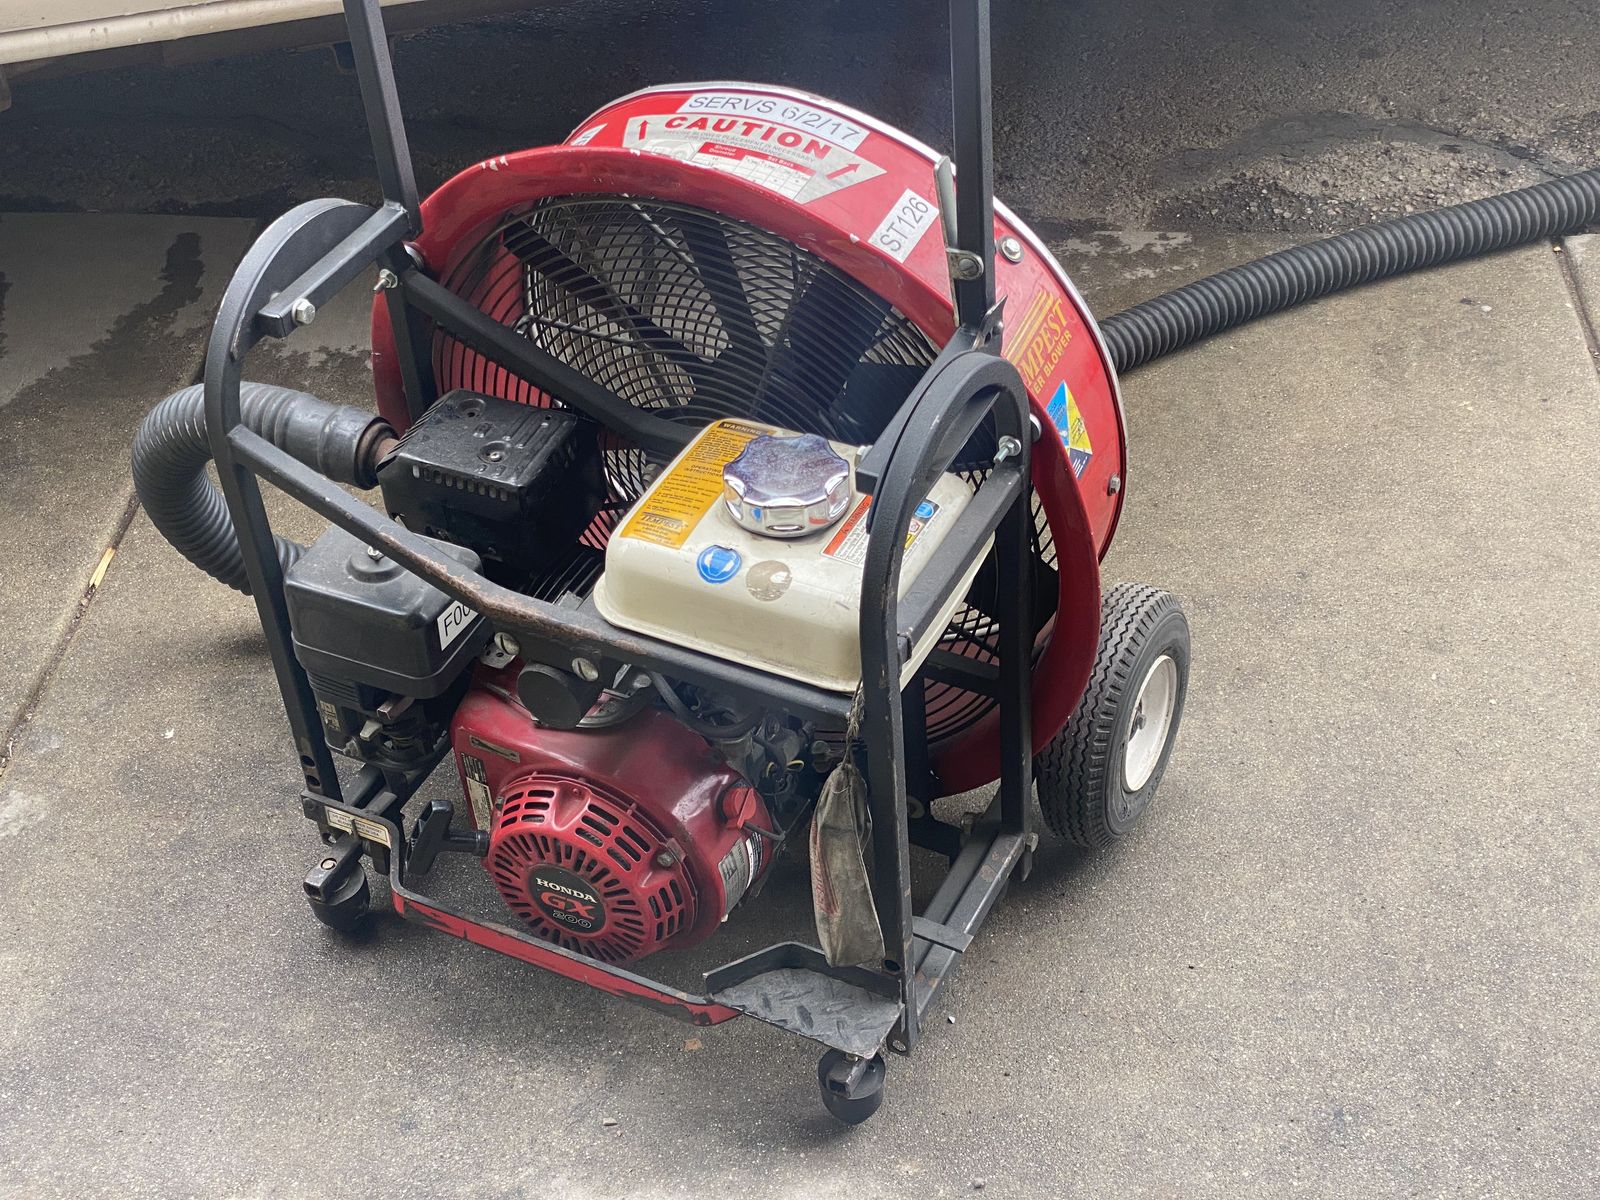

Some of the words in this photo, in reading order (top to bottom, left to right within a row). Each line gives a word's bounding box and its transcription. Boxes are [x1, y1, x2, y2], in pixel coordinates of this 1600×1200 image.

[688, 95, 777, 114] SERVS
[781, 106, 860, 140] 6/2/17
[664, 115, 832, 160] CAUTION
[692, 130, 723, 141] BLOWER
[722, 134, 766, 147] PLACEMENT
[773, 143, 816, 163] NECESSARY
[880, 197, 928, 252] ST126
[1016, 297, 1068, 387] MPEST
[1031, 376, 1046, 395] ER
[1042, 329, 1073, 378] BLOWER
[723, 423, 762, 435] WARNING
[535, 877, 598, 904] HONDA
[540, 891, 596, 920] GX
[552, 909, 592, 929] 200
